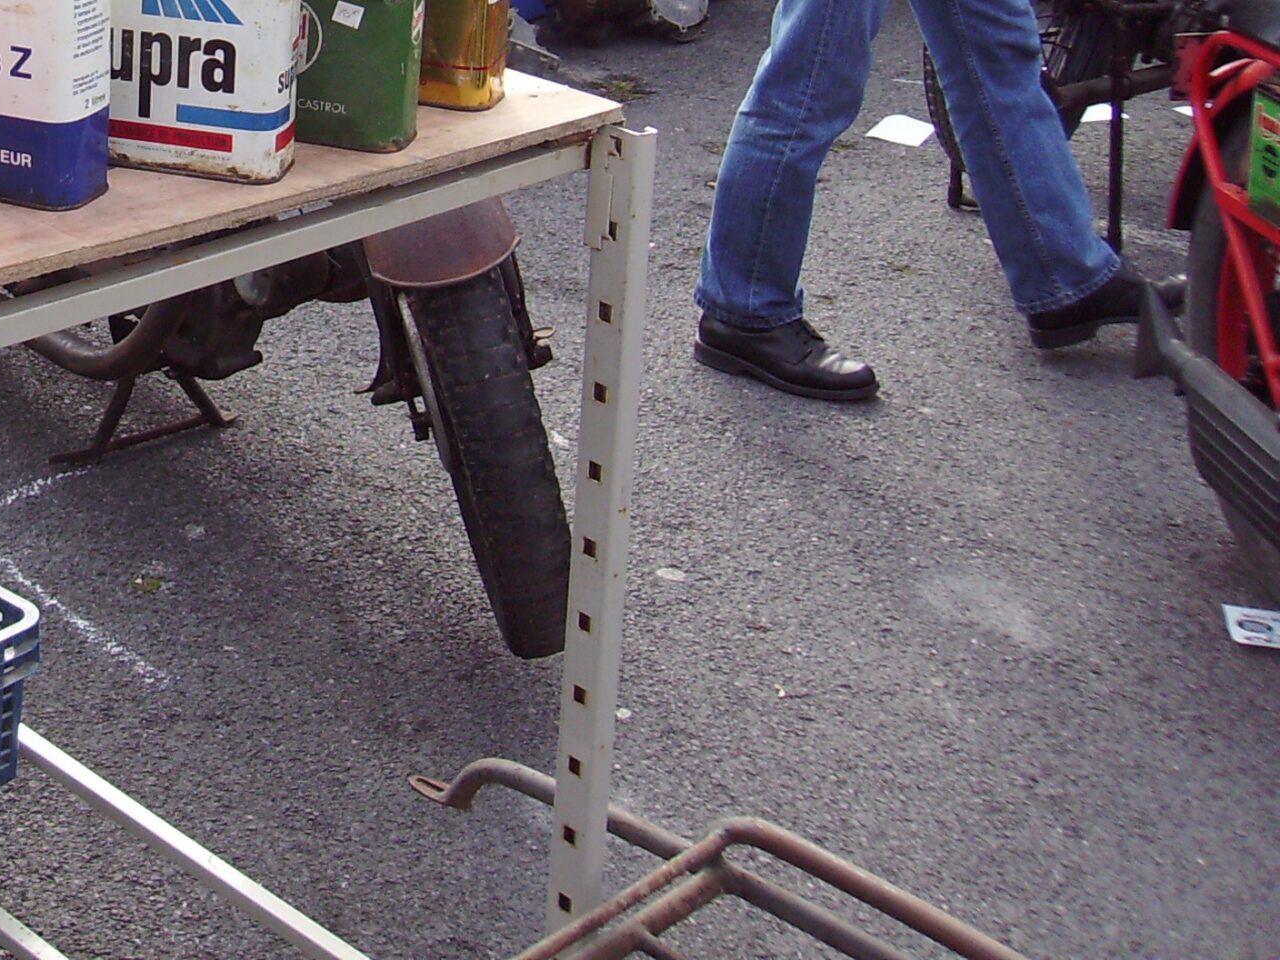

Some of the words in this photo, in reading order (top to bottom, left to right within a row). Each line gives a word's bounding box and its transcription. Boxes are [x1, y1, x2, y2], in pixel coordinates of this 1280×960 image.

[9, 45, 33, 79] Z
[110, 27, 237, 118] upra
[297, 99, 347, 115] CASTROL
